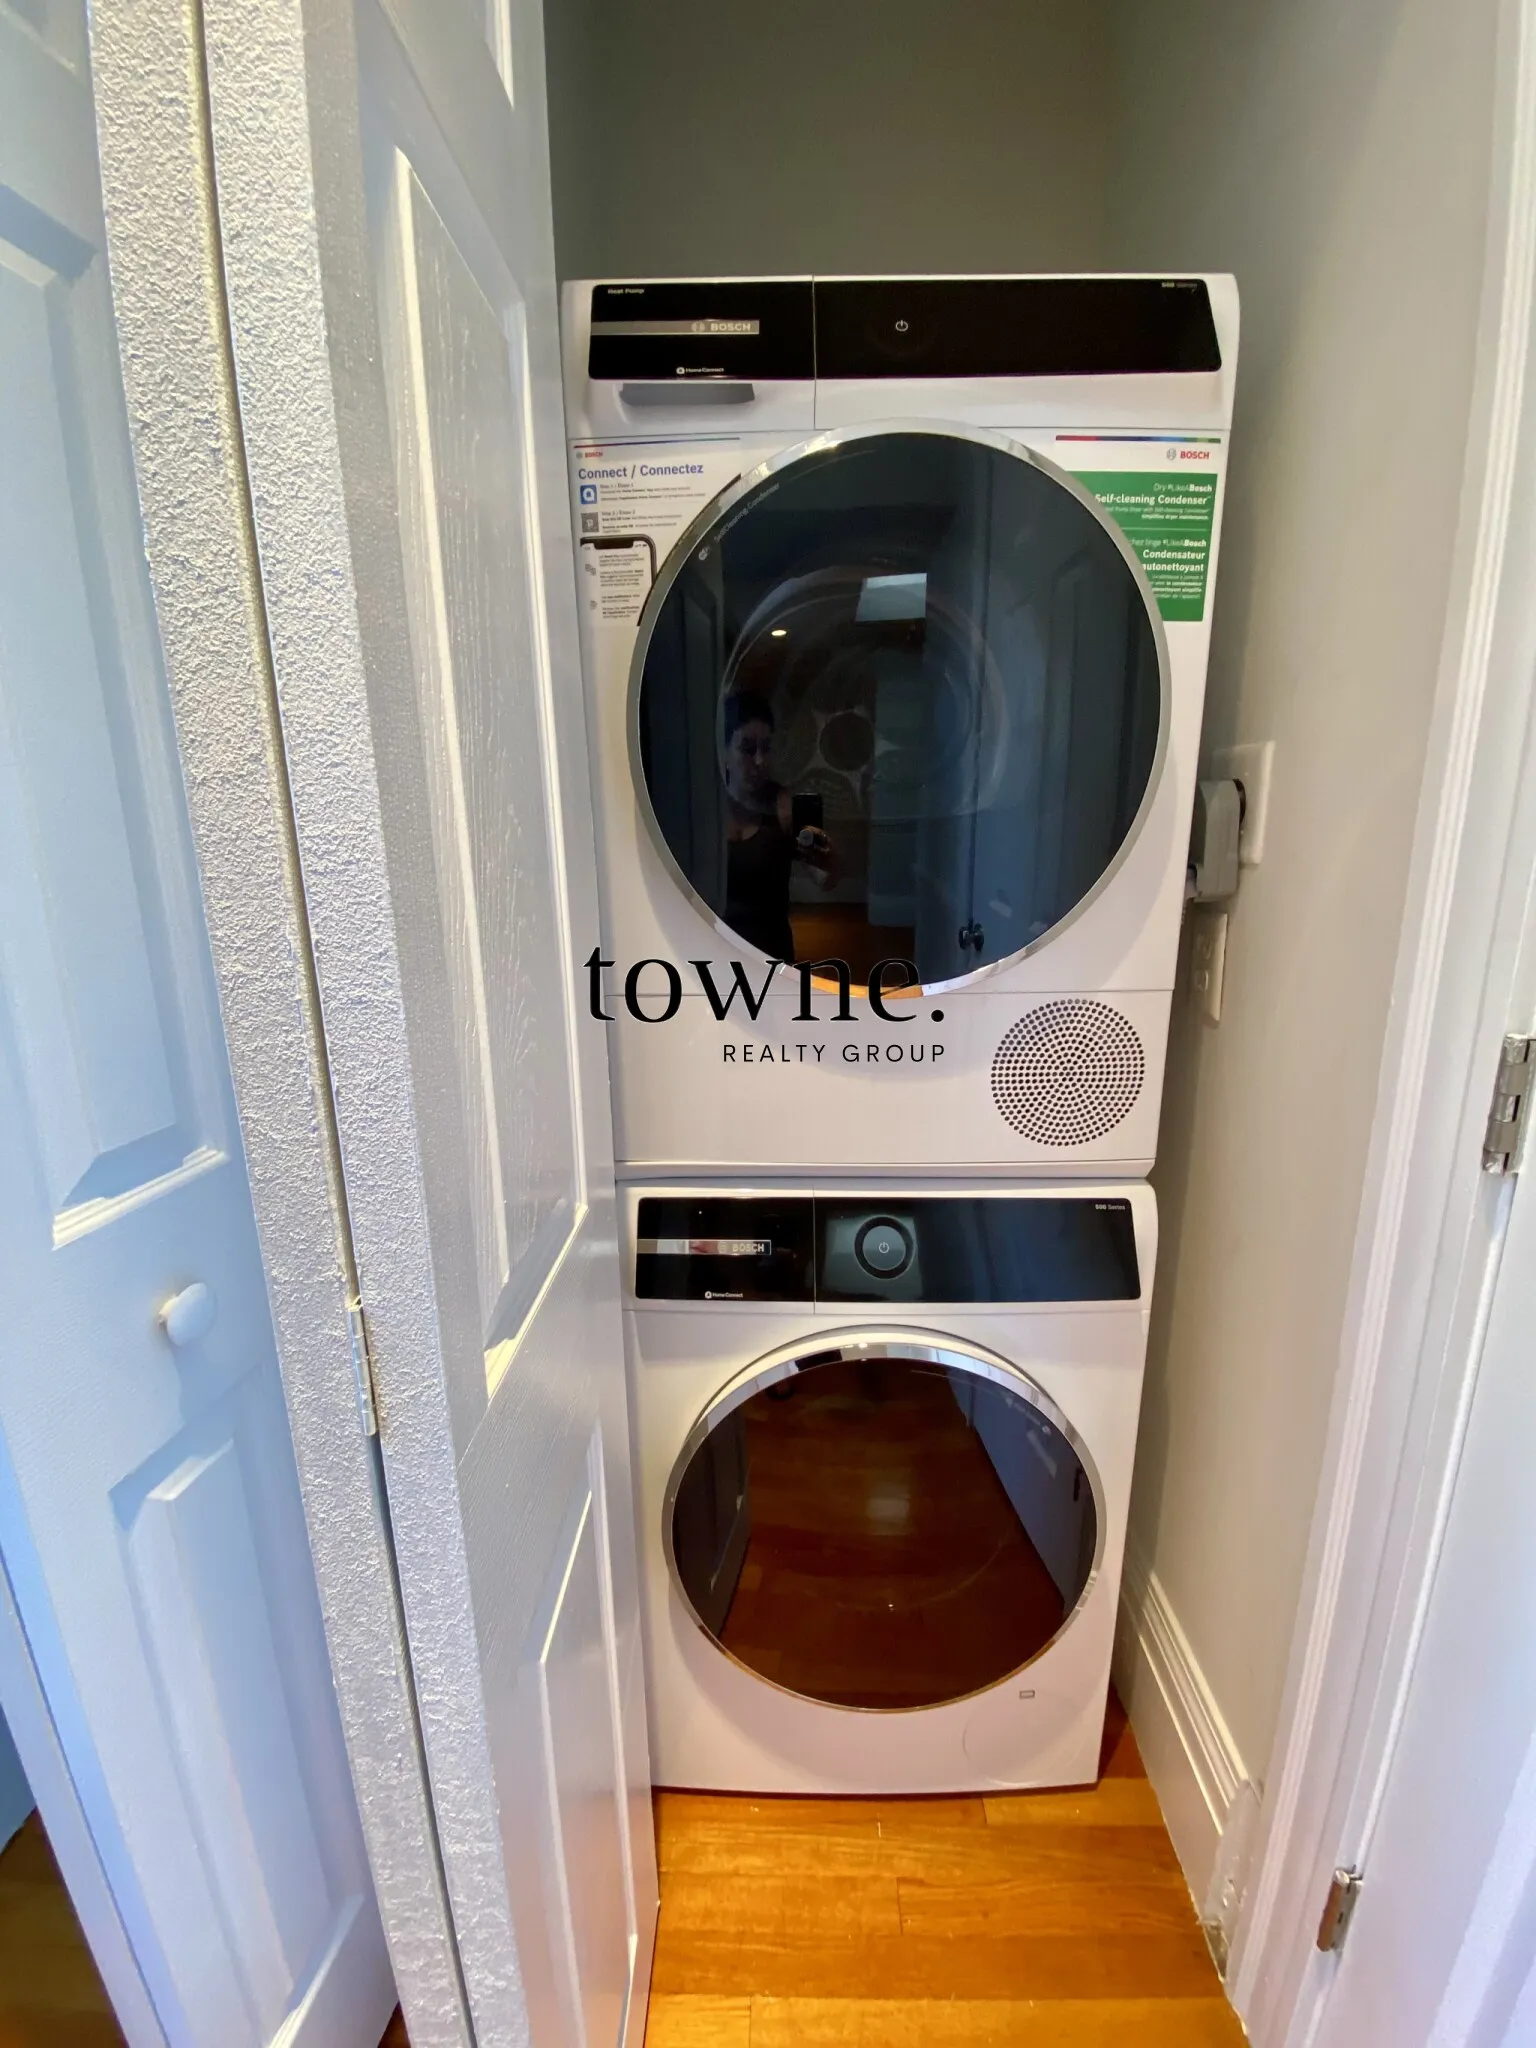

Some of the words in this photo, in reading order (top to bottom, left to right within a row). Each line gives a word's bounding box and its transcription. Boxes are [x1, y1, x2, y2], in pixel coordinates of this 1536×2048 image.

[710, 322, 751, 332] BOSCH
[1180, 451, 1210, 460] BOSCH
[578, 467, 628, 480] Connect
[631, 464, 636, 479] /
[640, 463, 704, 478] Connectez
[1153, 483, 1167, 492] Dry
[1095, 493, 1156, 506] Self-cleaning
[1157, 494, 1208, 505] Condenser
[1143, 549, 1206, 560] Condensateur
[732, 1243, 765, 1253] BOSCH
